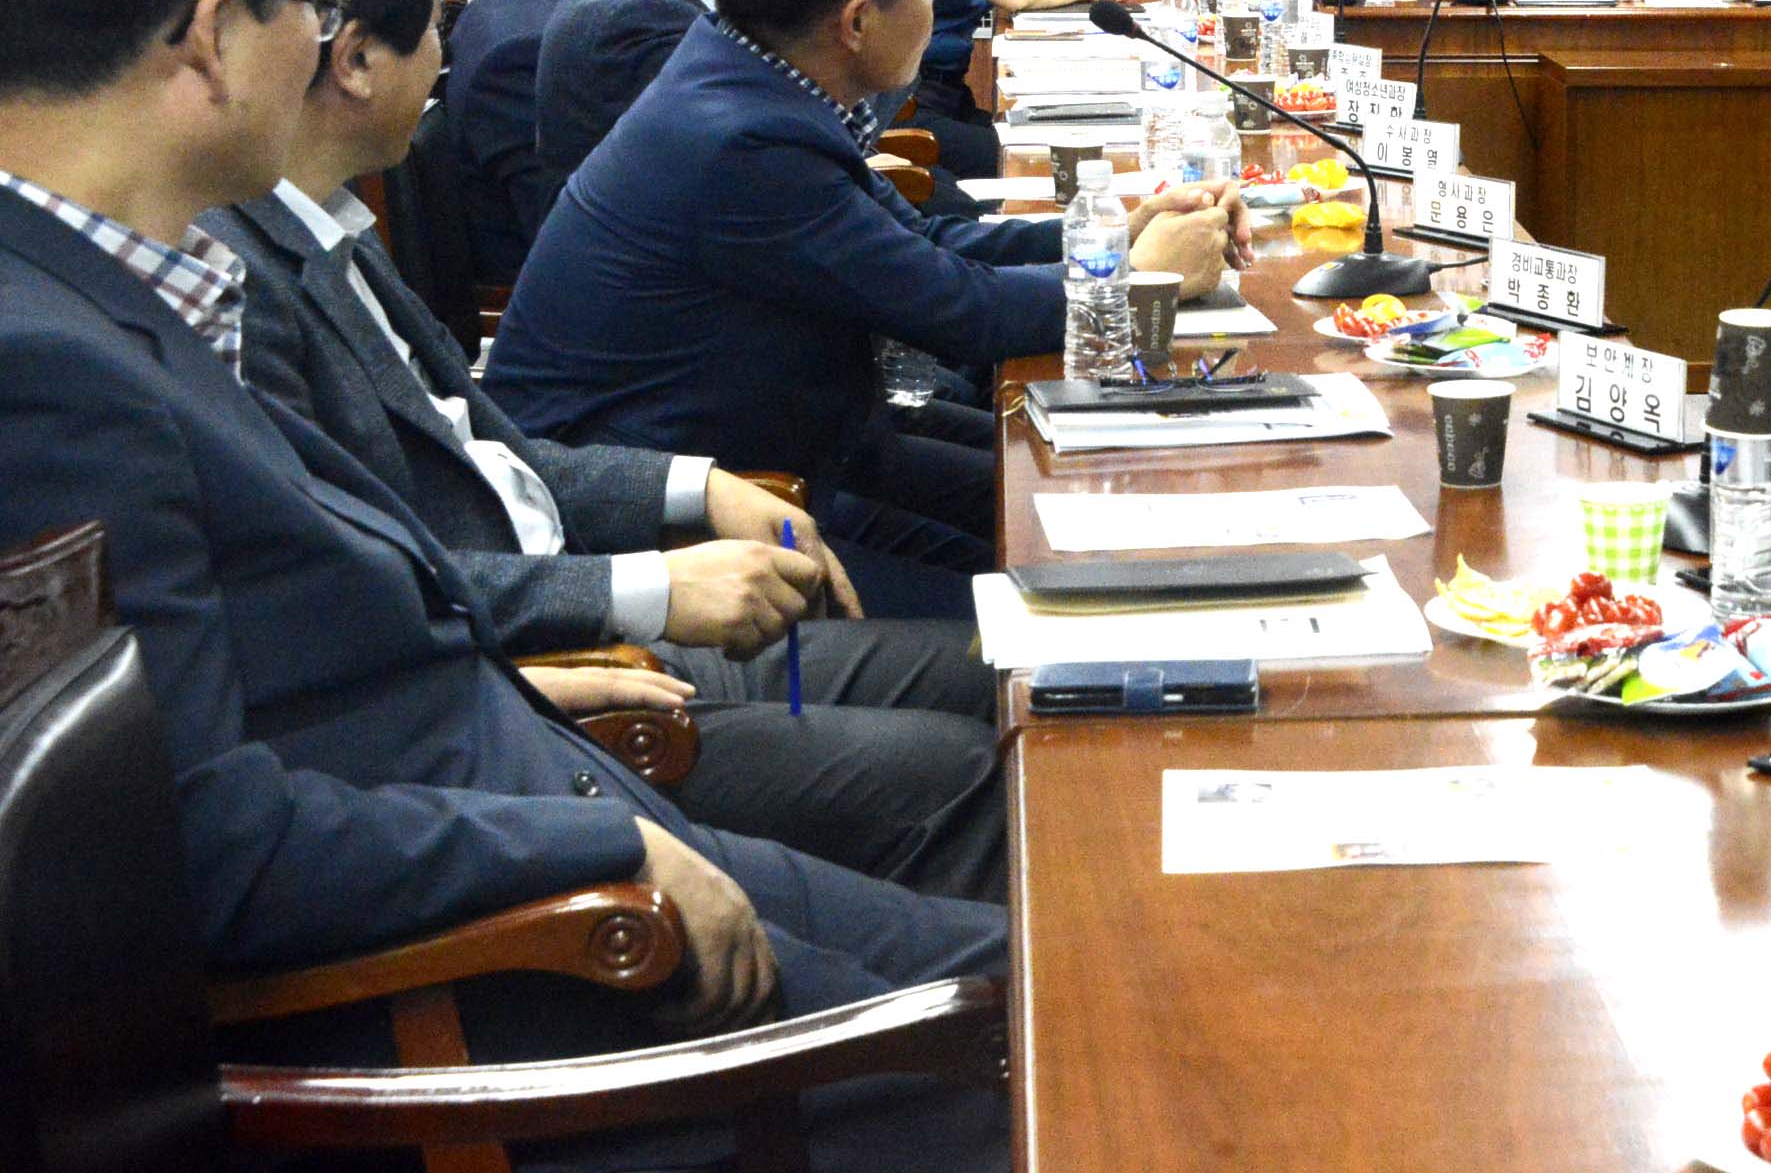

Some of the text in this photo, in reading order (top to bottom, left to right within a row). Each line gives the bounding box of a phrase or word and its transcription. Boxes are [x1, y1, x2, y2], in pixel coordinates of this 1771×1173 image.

[1511, 252, 1578, 285] 경비교통과장
[1507, 277, 1580, 317] 박종환
[1586, 344, 1654, 384] 보안계장
